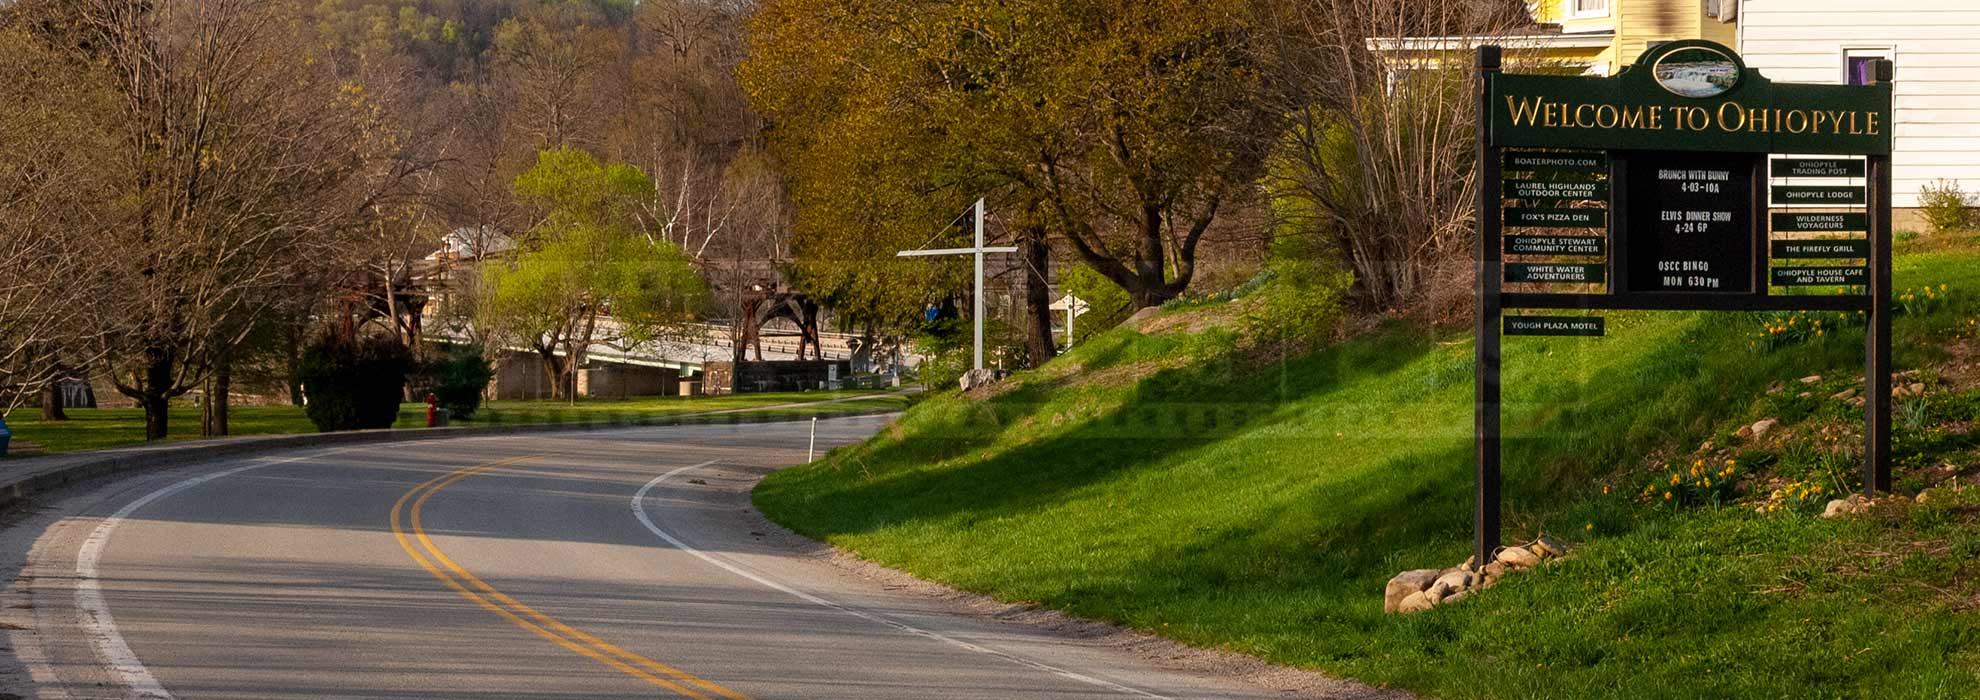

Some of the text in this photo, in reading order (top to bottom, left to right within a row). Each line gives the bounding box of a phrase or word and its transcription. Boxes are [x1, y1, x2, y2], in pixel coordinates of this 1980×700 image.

[1514, 158, 1597, 167] BOATERPHOTO.COM
[1799, 161, 1837, 169] OHIOPYLE
[1658, 169, 1730, 182] BRUNCH WITH BUNNY
[1792, 168, 1848, 176] TRADING POST
[1515, 182, 1596, 191] LAUREL HIGHLANDS
[1518, 189, 1593, 198] OUTDOOR CENTER
[1786, 191, 1854, 199] OHIOPYLE LODGE
[1521, 213, 1545, 221] FOX'S
[1572, 214, 1590, 222] DEN
[1661, 210, 1732, 222] ELVIS DINNER SHOW
[1796, 215, 1844, 223] WILDERNESS
[1675, 222, 1708, 234] 4-24 6P
[1796, 222, 1844, 230] VOYAGEURS
[1514, 237, 1597, 246] OHIOPYLE STEWART
[1513, 244, 1599, 253] COMMUNITY CENTER
[1786, 245, 1855, 253] THE FIREFLY GRILL
[1527, 265, 1585, 273] WHITE WATER
[1658, 260, 1709, 272] OSCC BINGO
[1526, 272, 1585, 281] ADVENTURERS
[1777, 269, 1816, 277] OHIOPYLE
[1817, 269, 1844, 277] HOUSE
[1663, 275, 1720, 289] MON 630 PM
[1796, 276, 1815, 284] AND
[1511, 322, 1599, 331] YOUGH PLAZA MOTEL
